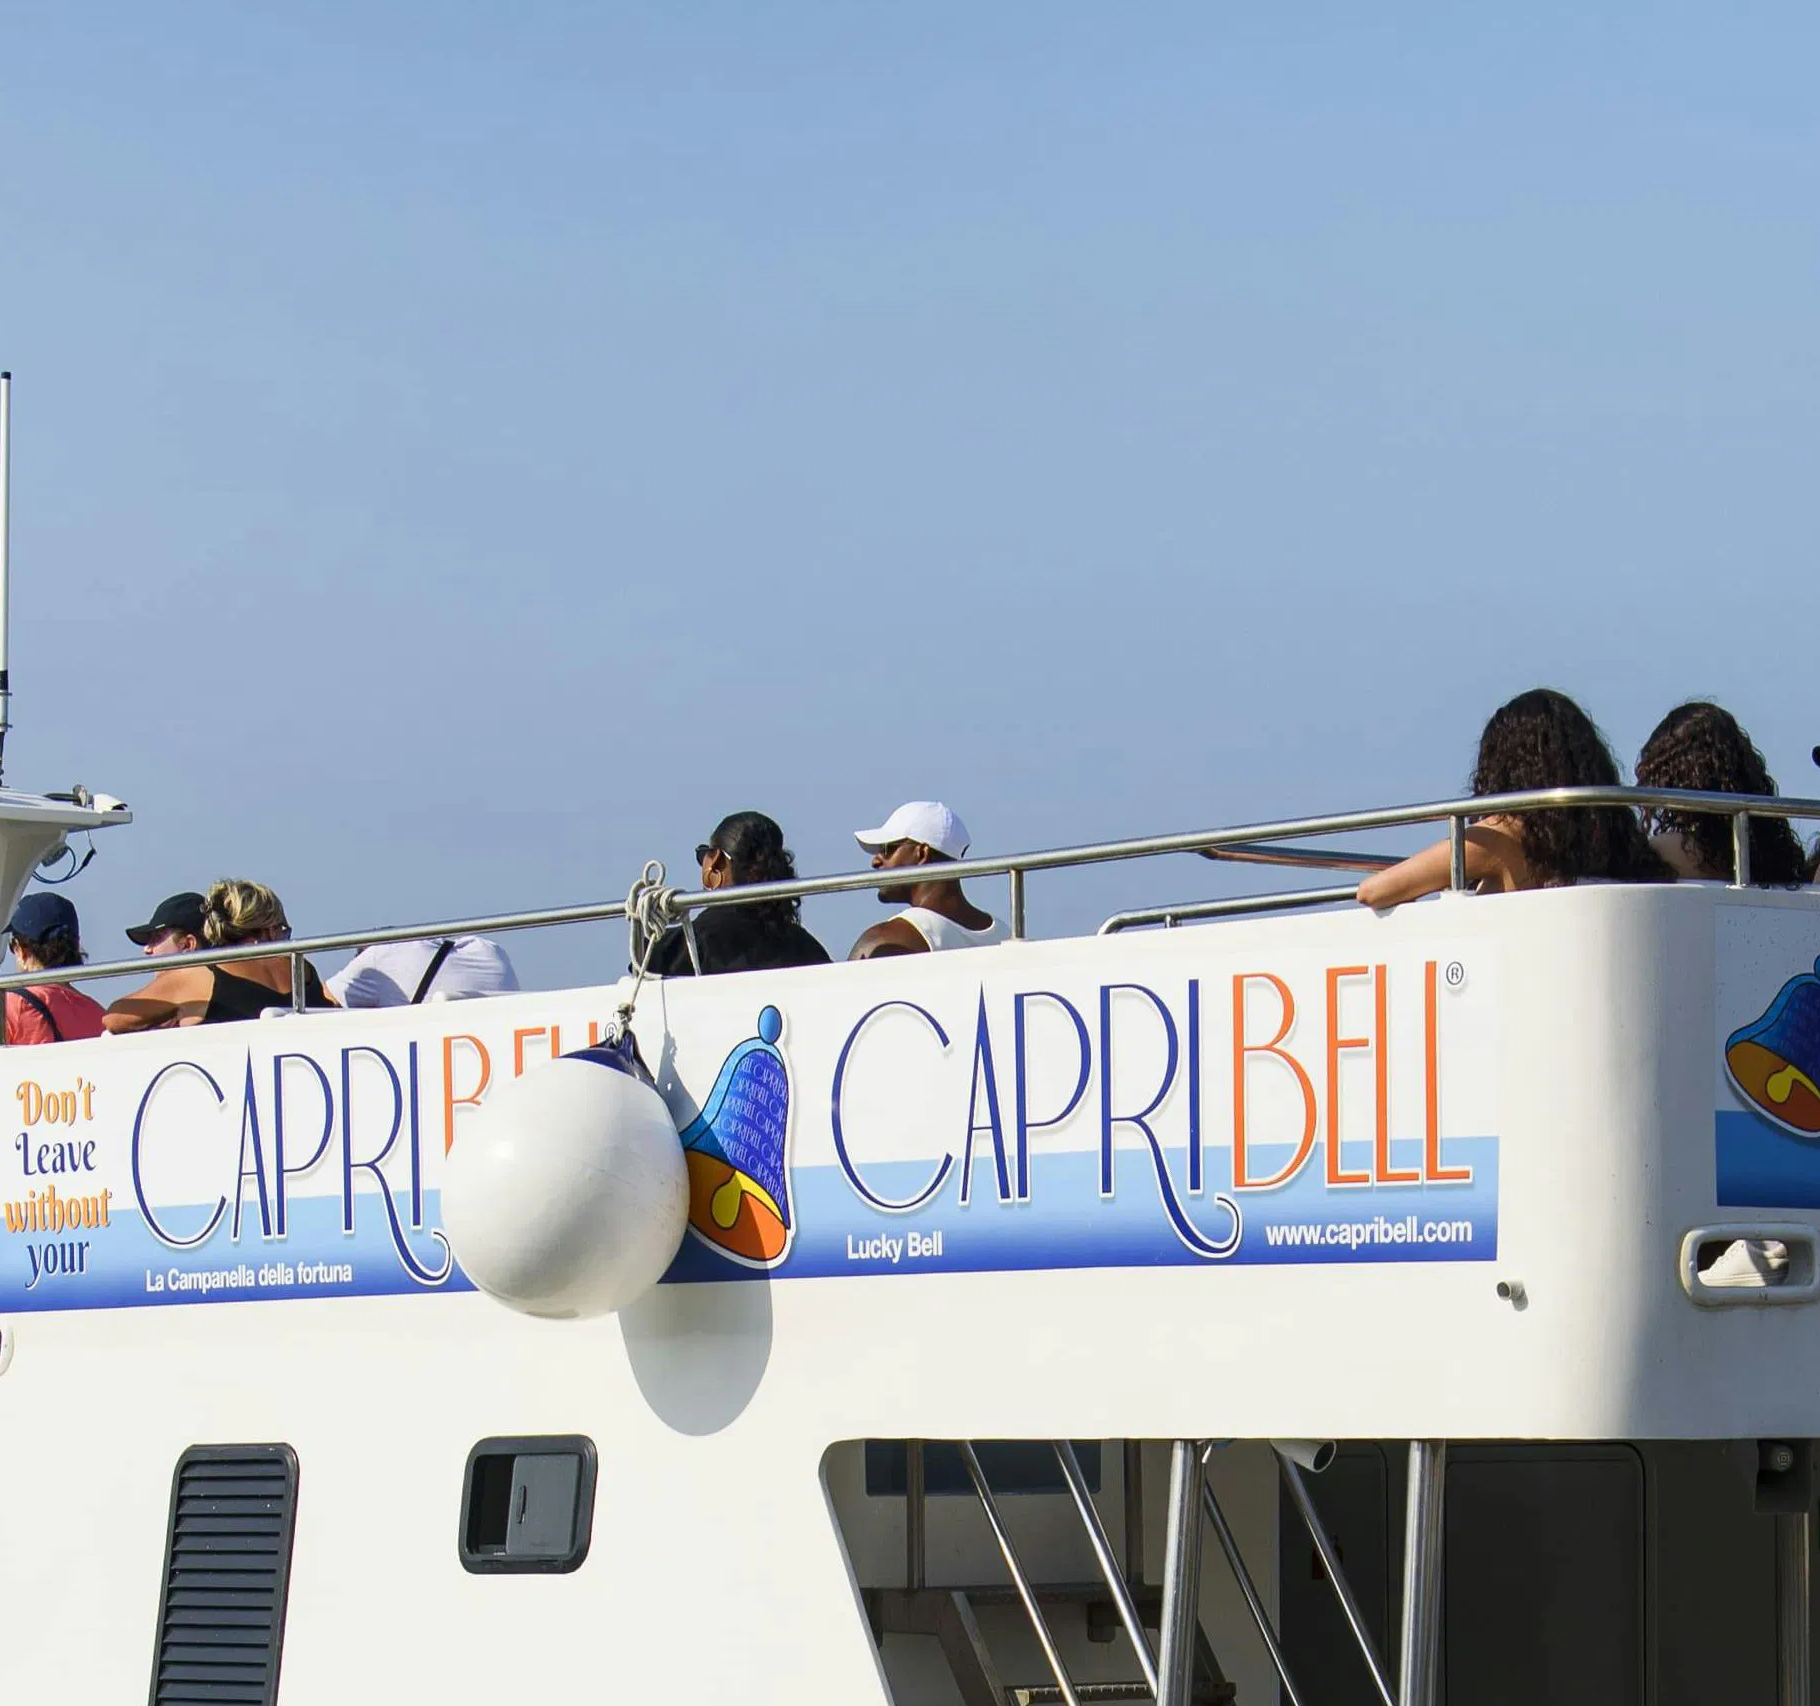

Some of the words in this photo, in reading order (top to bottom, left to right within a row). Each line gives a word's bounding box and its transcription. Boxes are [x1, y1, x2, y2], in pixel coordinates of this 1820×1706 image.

[16, 1077, 95, 1126] Don't
[832, 960, 1473, 1256] CAPRIBELL
[15, 1132, 96, 1175] Leave
[132, 1022, 598, 1282] CAPRI
[5, 1184, 112, 1233] without
[1265, 1217, 1472, 1247] www.capribell.com
[25, 1240, 90, 1289] your
[847, 1234, 903, 1263] Lucky
[908, 1232, 942, 1257] Bell
[146, 1269, 164, 1292] La
[168, 1264, 255, 1294] Campanella
[259, 1263, 294, 1286] della
[297, 1261, 353, 1284] fortuna
